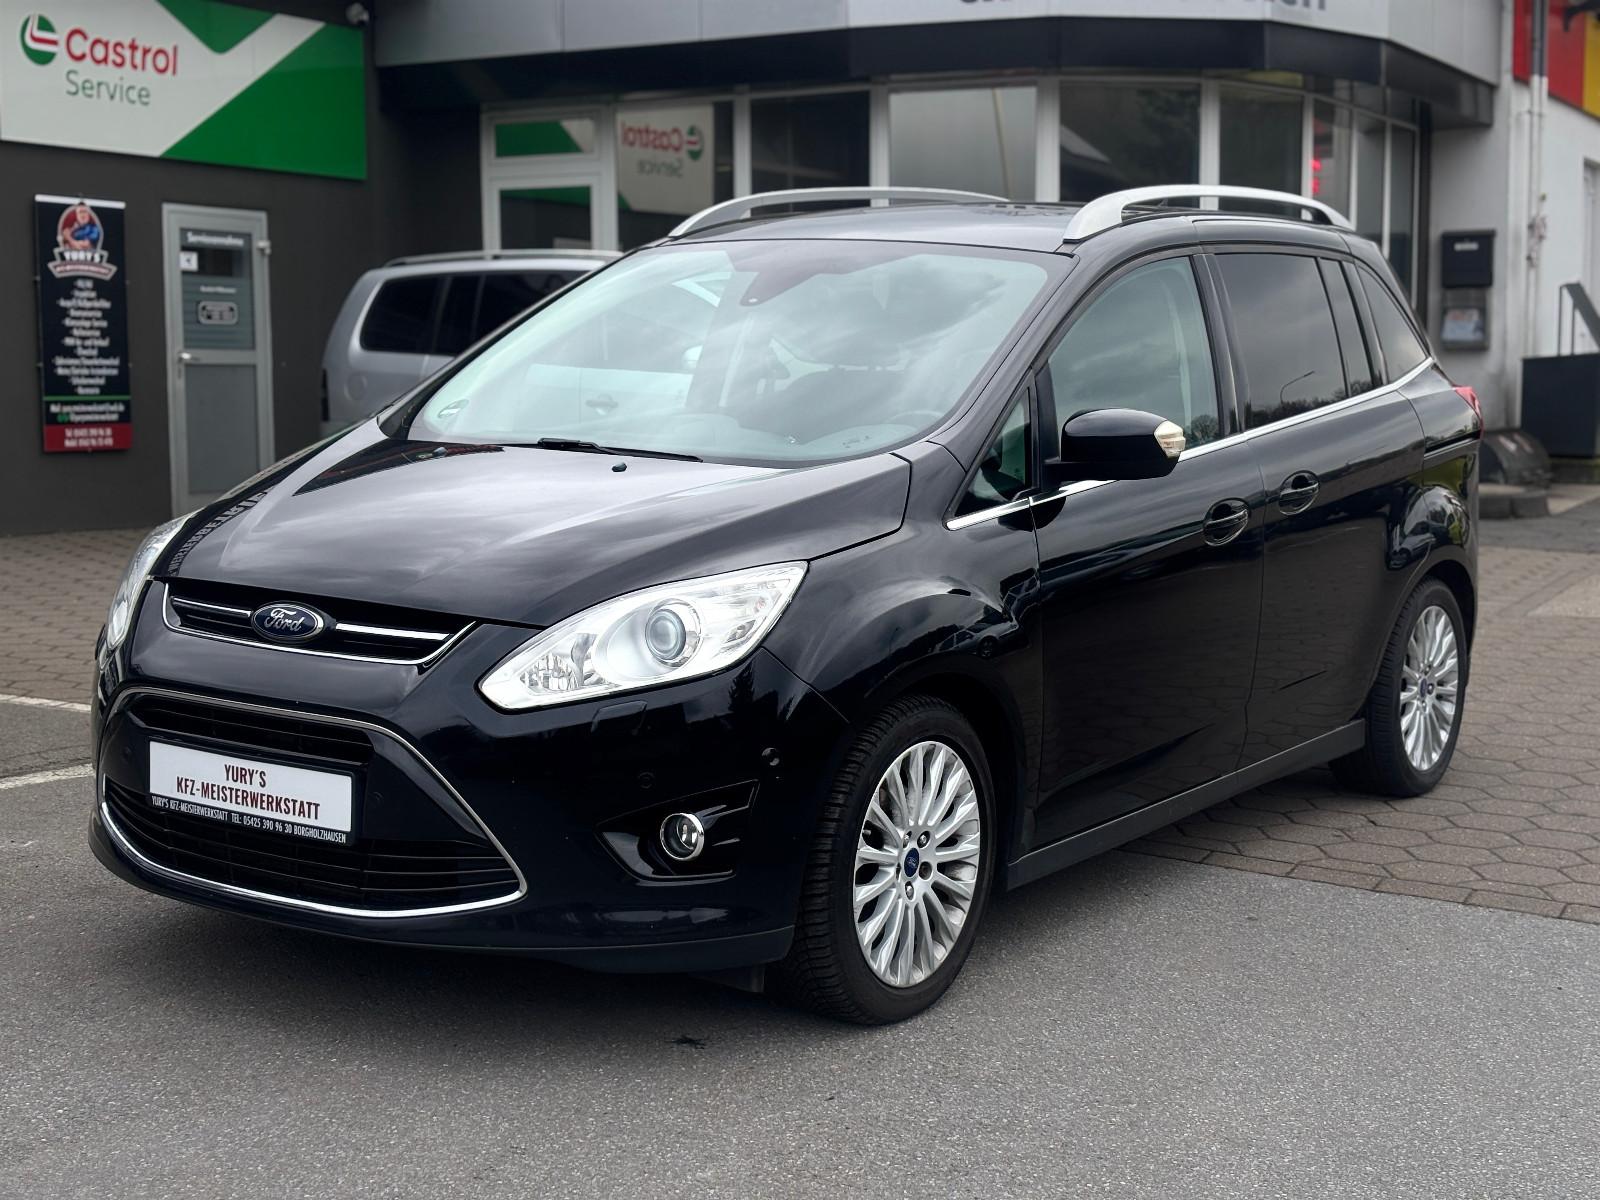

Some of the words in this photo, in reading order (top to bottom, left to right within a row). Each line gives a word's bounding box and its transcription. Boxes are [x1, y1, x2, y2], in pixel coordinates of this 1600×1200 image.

[65, 28, 178, 76] Castrol
[65, 69, 151, 106] Service
[264, 608, 305, 632] Ford
[224, 764, 266, 788] YURY'S
[176, 776, 321, 820] KFZ-MEISTERWERKSTATT
[170, 800, 228, 821] KFZ-MEISTERWERKSTATT
[243, 815, 261, 828] 05425
[262, 819, 274, 831] 390
[275, 821, 283, 832] 96
[284, 823, 293, 834] 30
[293, 825, 346, 844] BORGHOLZHAUSEN
